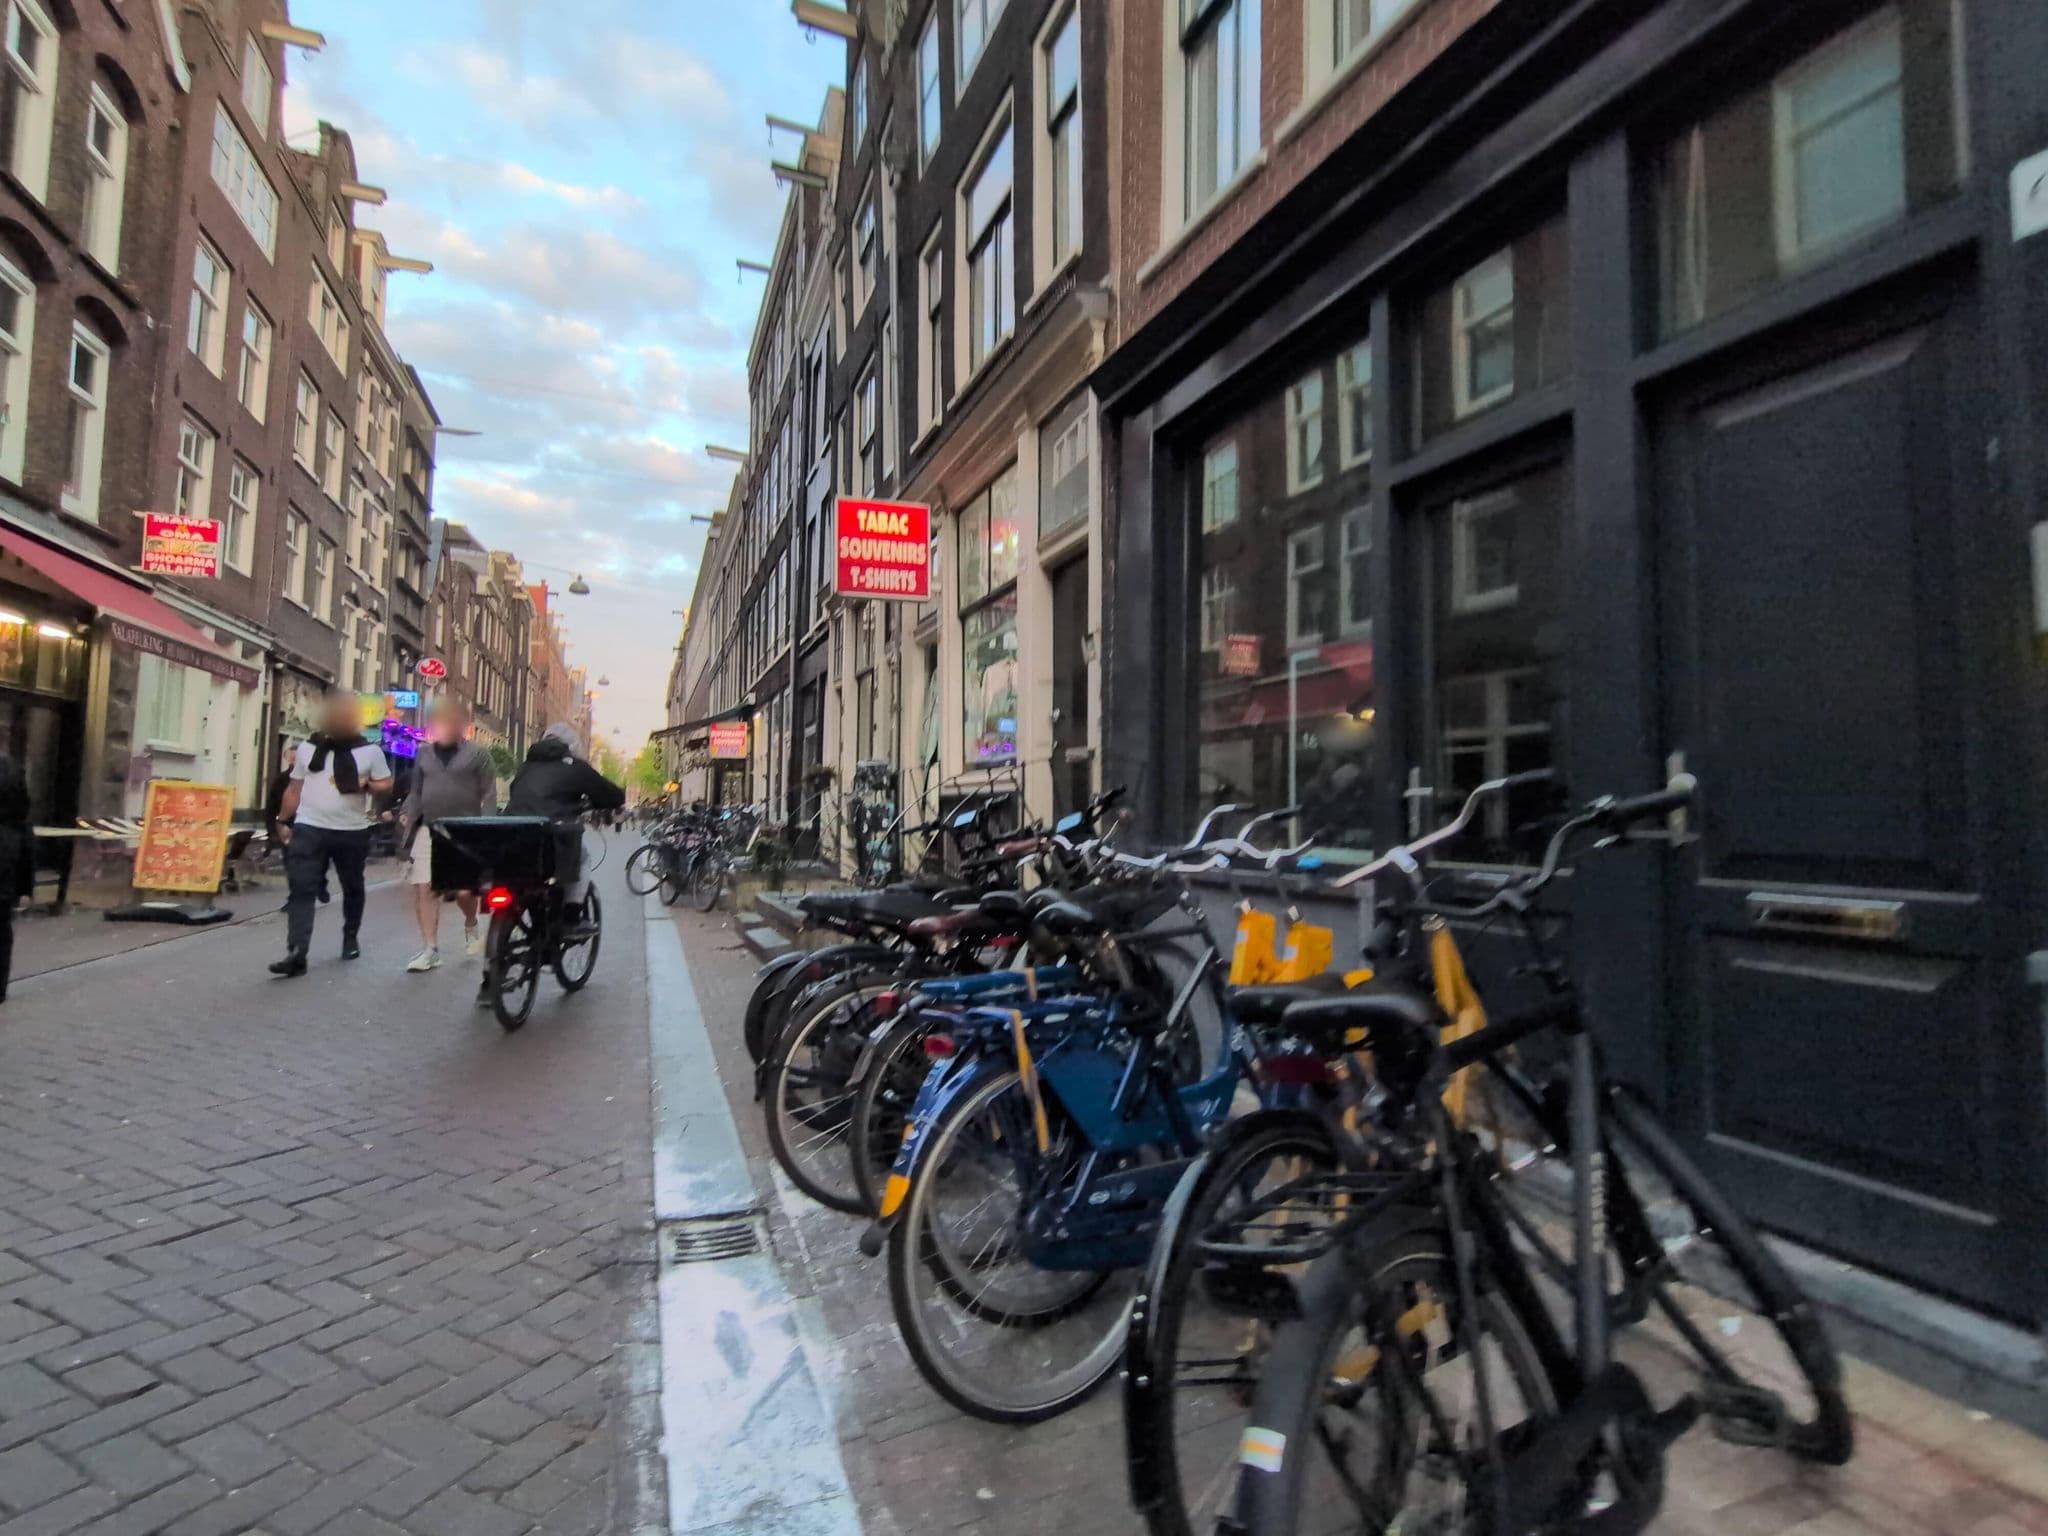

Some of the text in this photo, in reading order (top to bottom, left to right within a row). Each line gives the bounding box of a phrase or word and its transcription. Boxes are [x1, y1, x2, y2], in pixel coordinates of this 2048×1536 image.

[857, 509, 909, 536] TABAC
[159, 529, 204, 541] OMA
[146, 552, 214, 568] SHOARMA
[840, 537, 926, 565] SOUVENIRS
[149, 562, 208, 576] FALAFEL
[850, 567, 917, 592] T-SHIRTS
